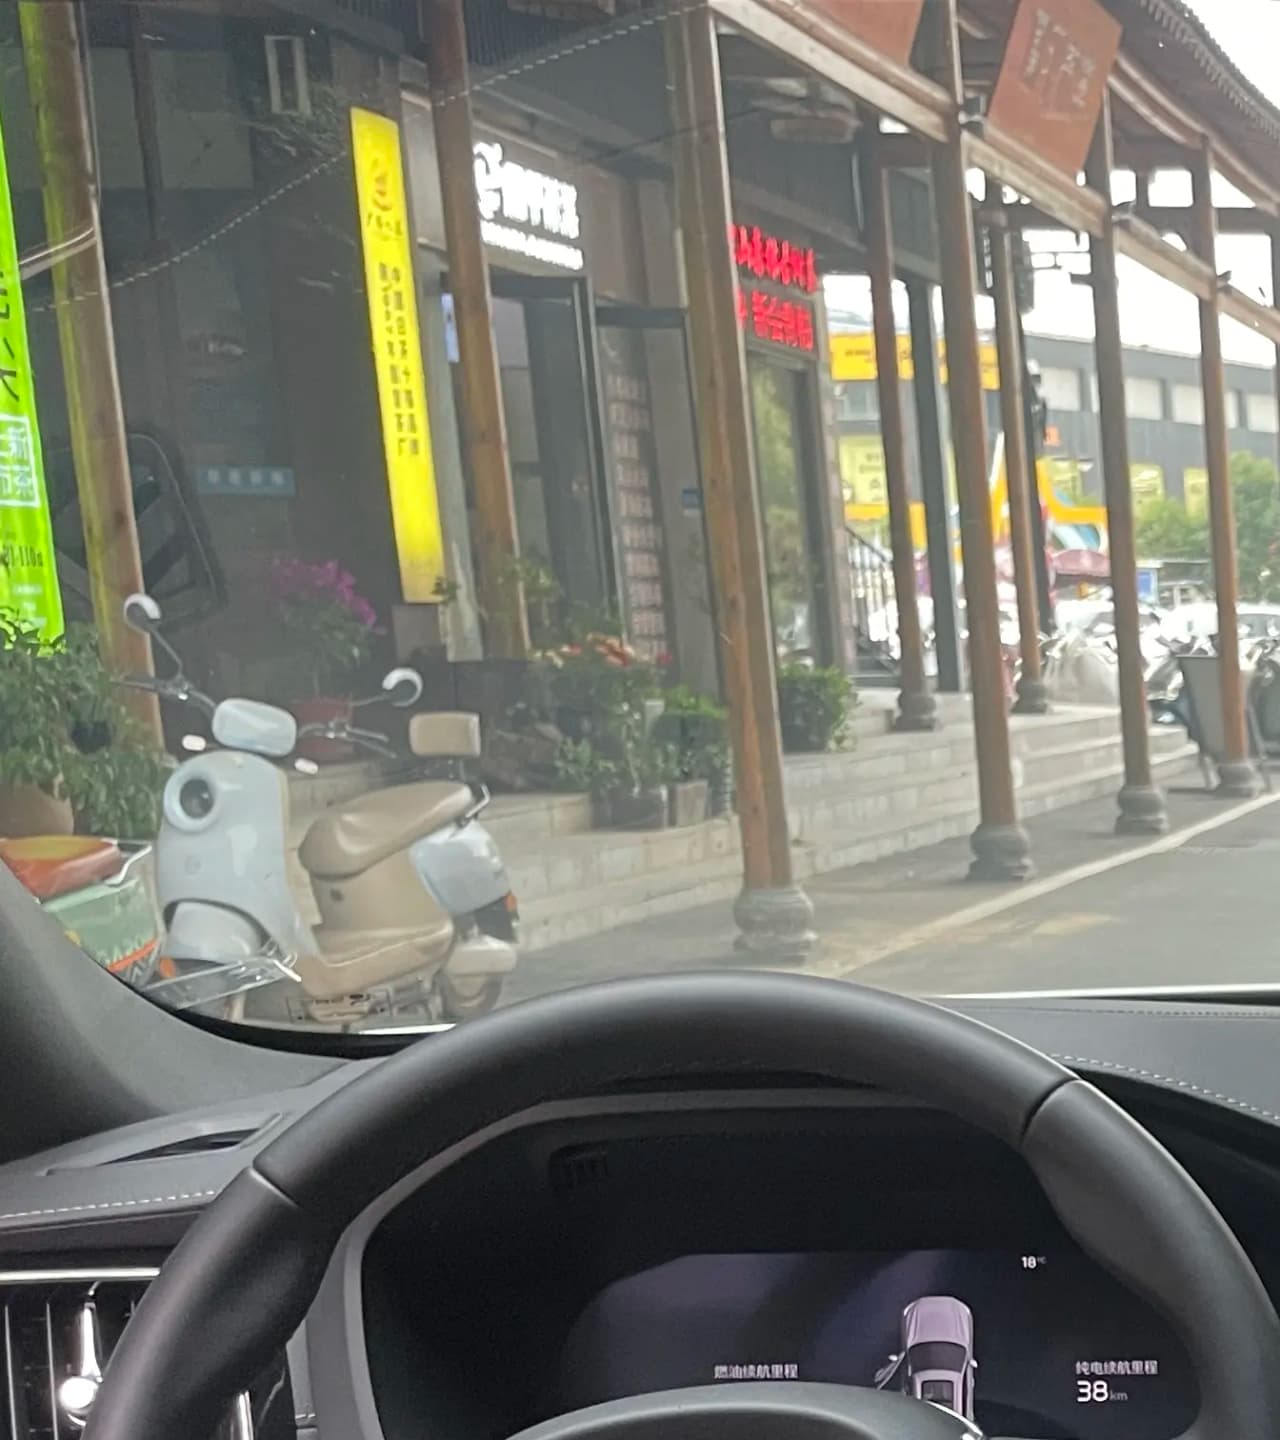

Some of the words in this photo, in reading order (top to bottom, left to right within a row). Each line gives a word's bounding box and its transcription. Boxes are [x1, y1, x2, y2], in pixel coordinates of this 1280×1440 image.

[1075, 1360, 1158, 1375] 纯电续航里程
